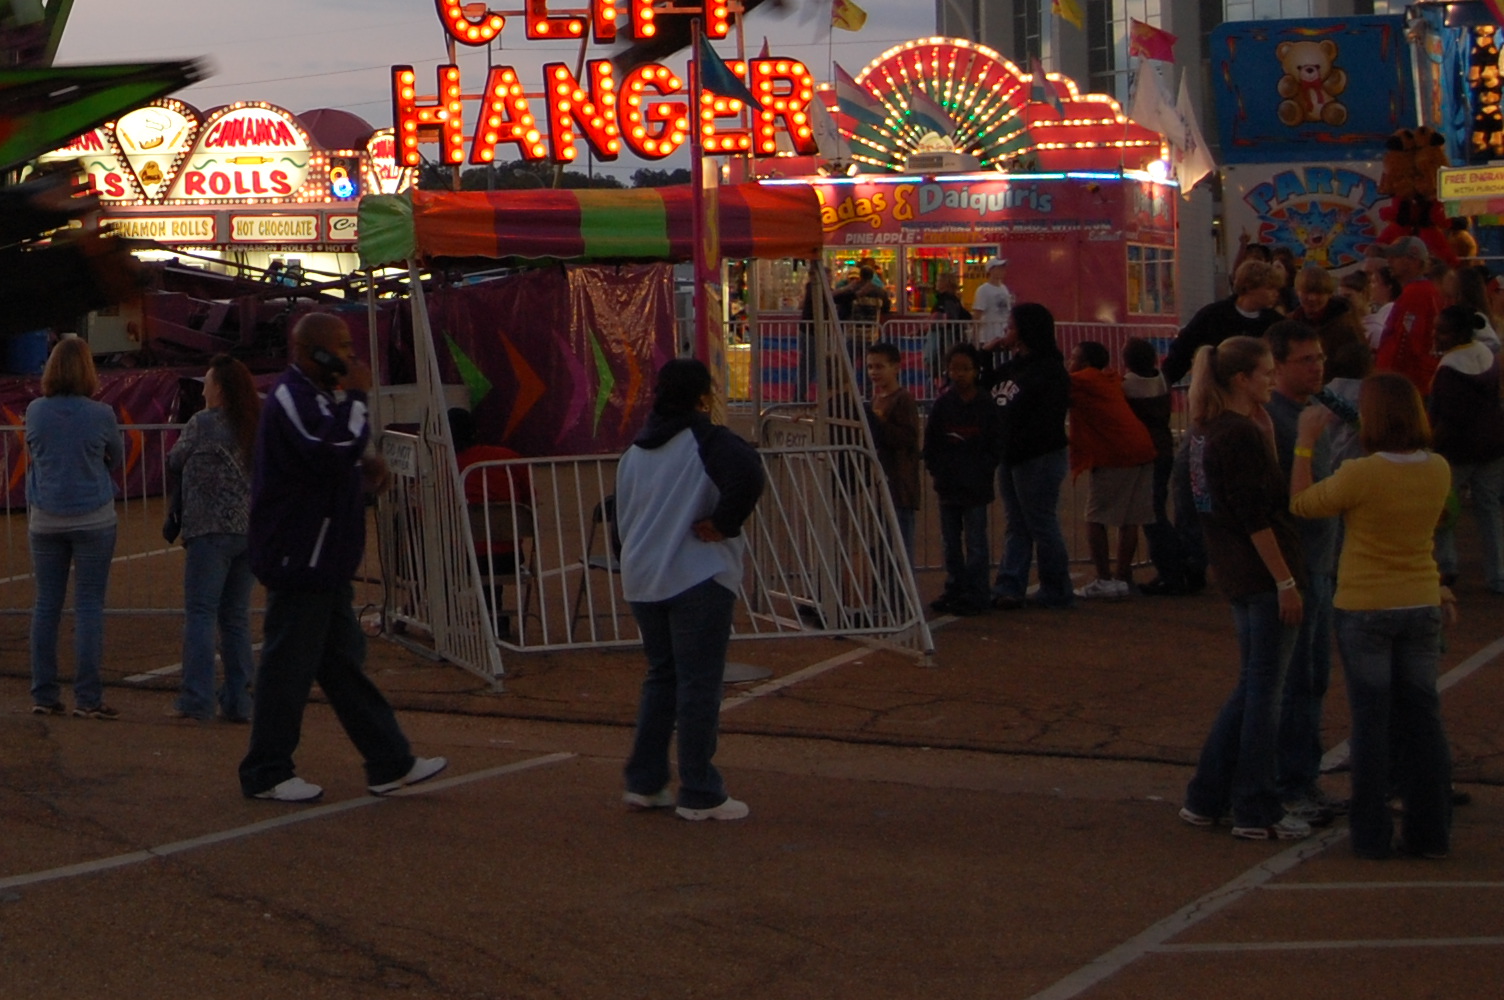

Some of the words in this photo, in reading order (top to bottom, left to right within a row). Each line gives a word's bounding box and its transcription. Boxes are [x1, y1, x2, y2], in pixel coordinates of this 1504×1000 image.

[391, 57, 819, 166] HANGER
[204, 116, 297, 148] CINNAMON
[184, 169, 292, 196] ROLLS
[1444, 173, 1466, 184] FREE
[1243, 166, 1389, 215] PARTY
[821, 192, 887, 225] adas
[892, 183, 915, 221] &
[919, 183, 1052, 216] Daiquiris
[171, 220, 210, 237] ROLLS
[236, 220, 255, 236] HOT
[258, 220, 313, 236] CHOCOLATE
[225, 243, 277, 252] CINNAMON
[281, 243, 313, 252] ROLLS
[325, 243, 347, 252] HOT
[773, 431, 785, 446] NO
[786, 432, 808, 447] EXIT
